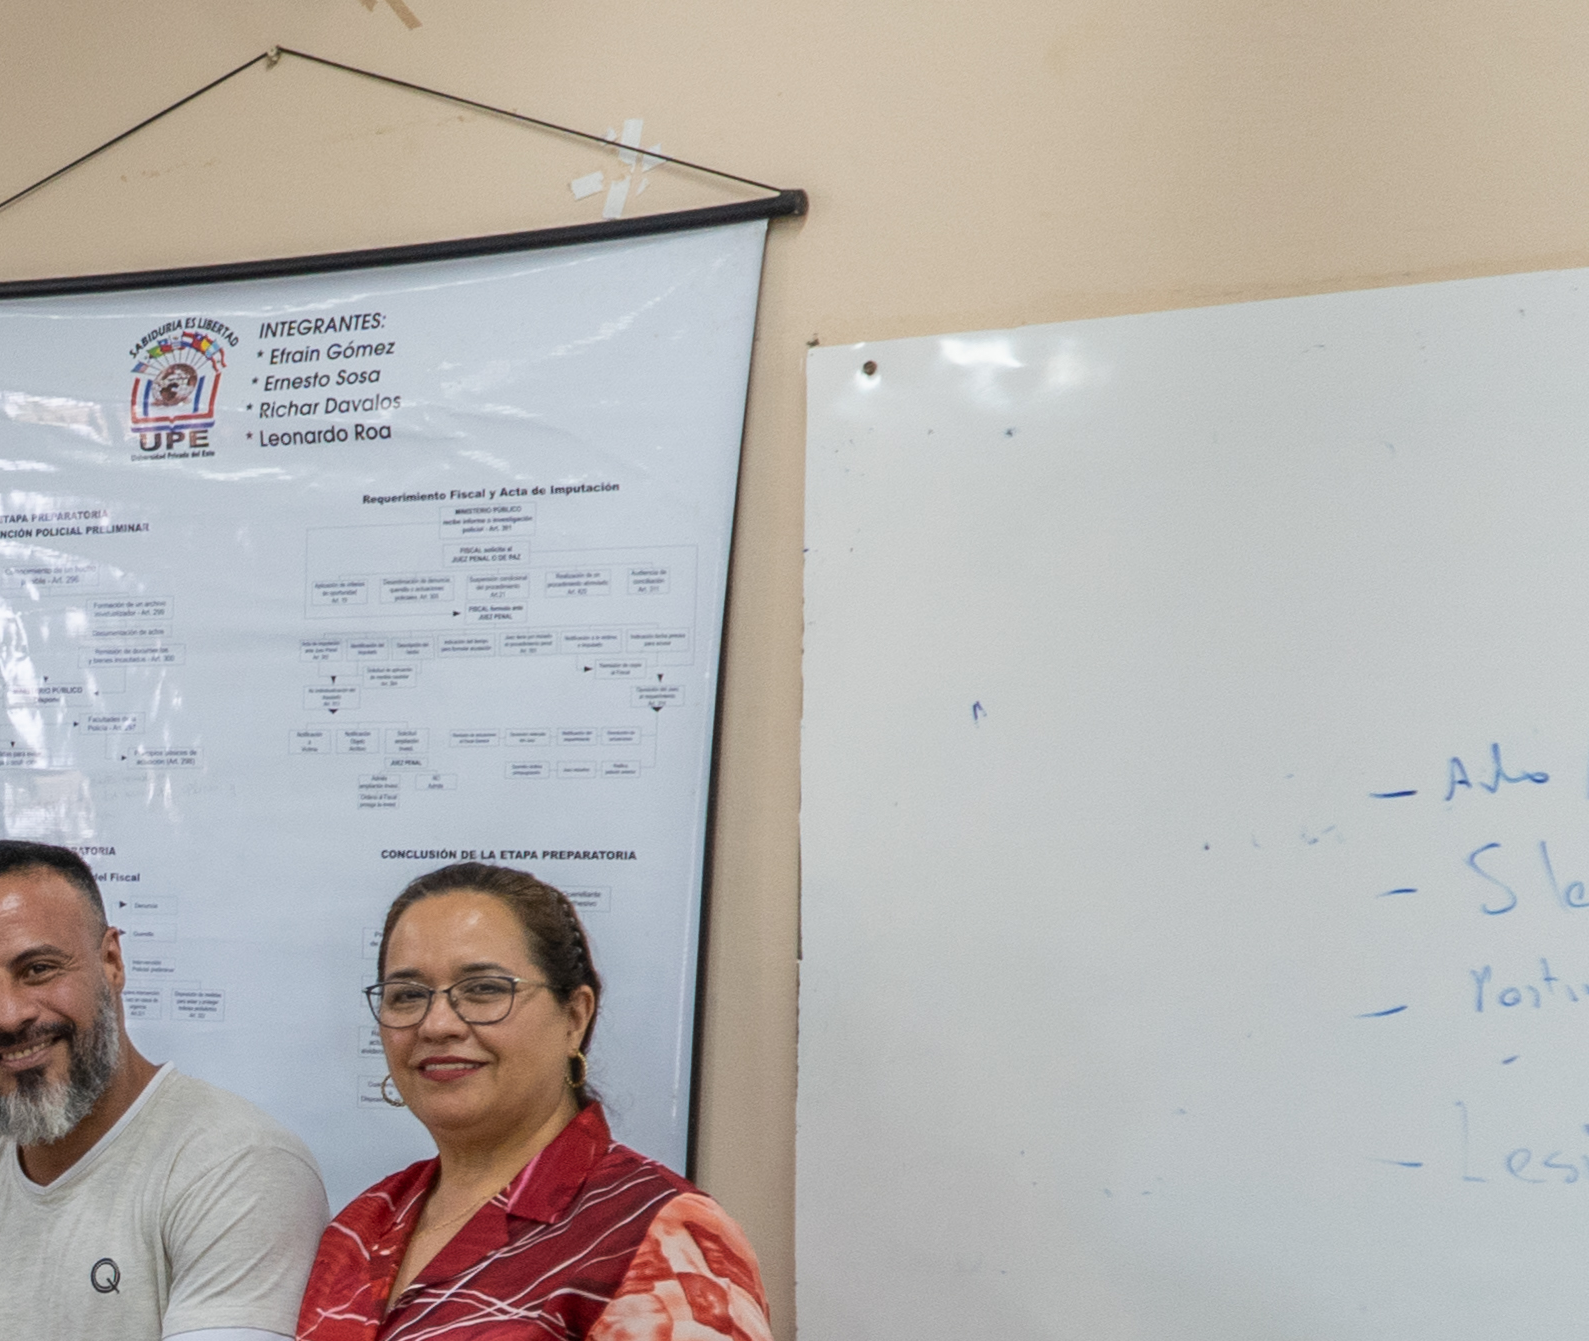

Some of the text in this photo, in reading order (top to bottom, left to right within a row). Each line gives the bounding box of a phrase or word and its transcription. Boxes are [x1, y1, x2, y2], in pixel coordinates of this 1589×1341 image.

[259, 312, 387, 339] INTEGRANTES:
[129, 318, 239, 359] SABIDURIA ES LIBERTAD
[270, 341, 396, 365] Efrain Gómez
[263, 368, 381, 392] Ernesto Sosa
[259, 393, 402, 419] Richar Davalos
[139, 430, 209, 452] UPE
[260, 423, 392, 447] Leonardo Roa
[362, 482, 620, 505] Requerimiento Fiscal y Acta de Imputación
[31, 509, 109, 523] PREPARATORIA
[35, 524, 83, 538] POLICIAL
[85, 523, 150, 536] PRELIMINAR
[71, 846, 116, 856] RATORIA
[381, 848, 637, 860] CONCLUSIÓN DE LA ETAPA PREPARATORIA
[110, 873, 140, 882] Fiscal
[90, 1257, 121, 1294] Q
